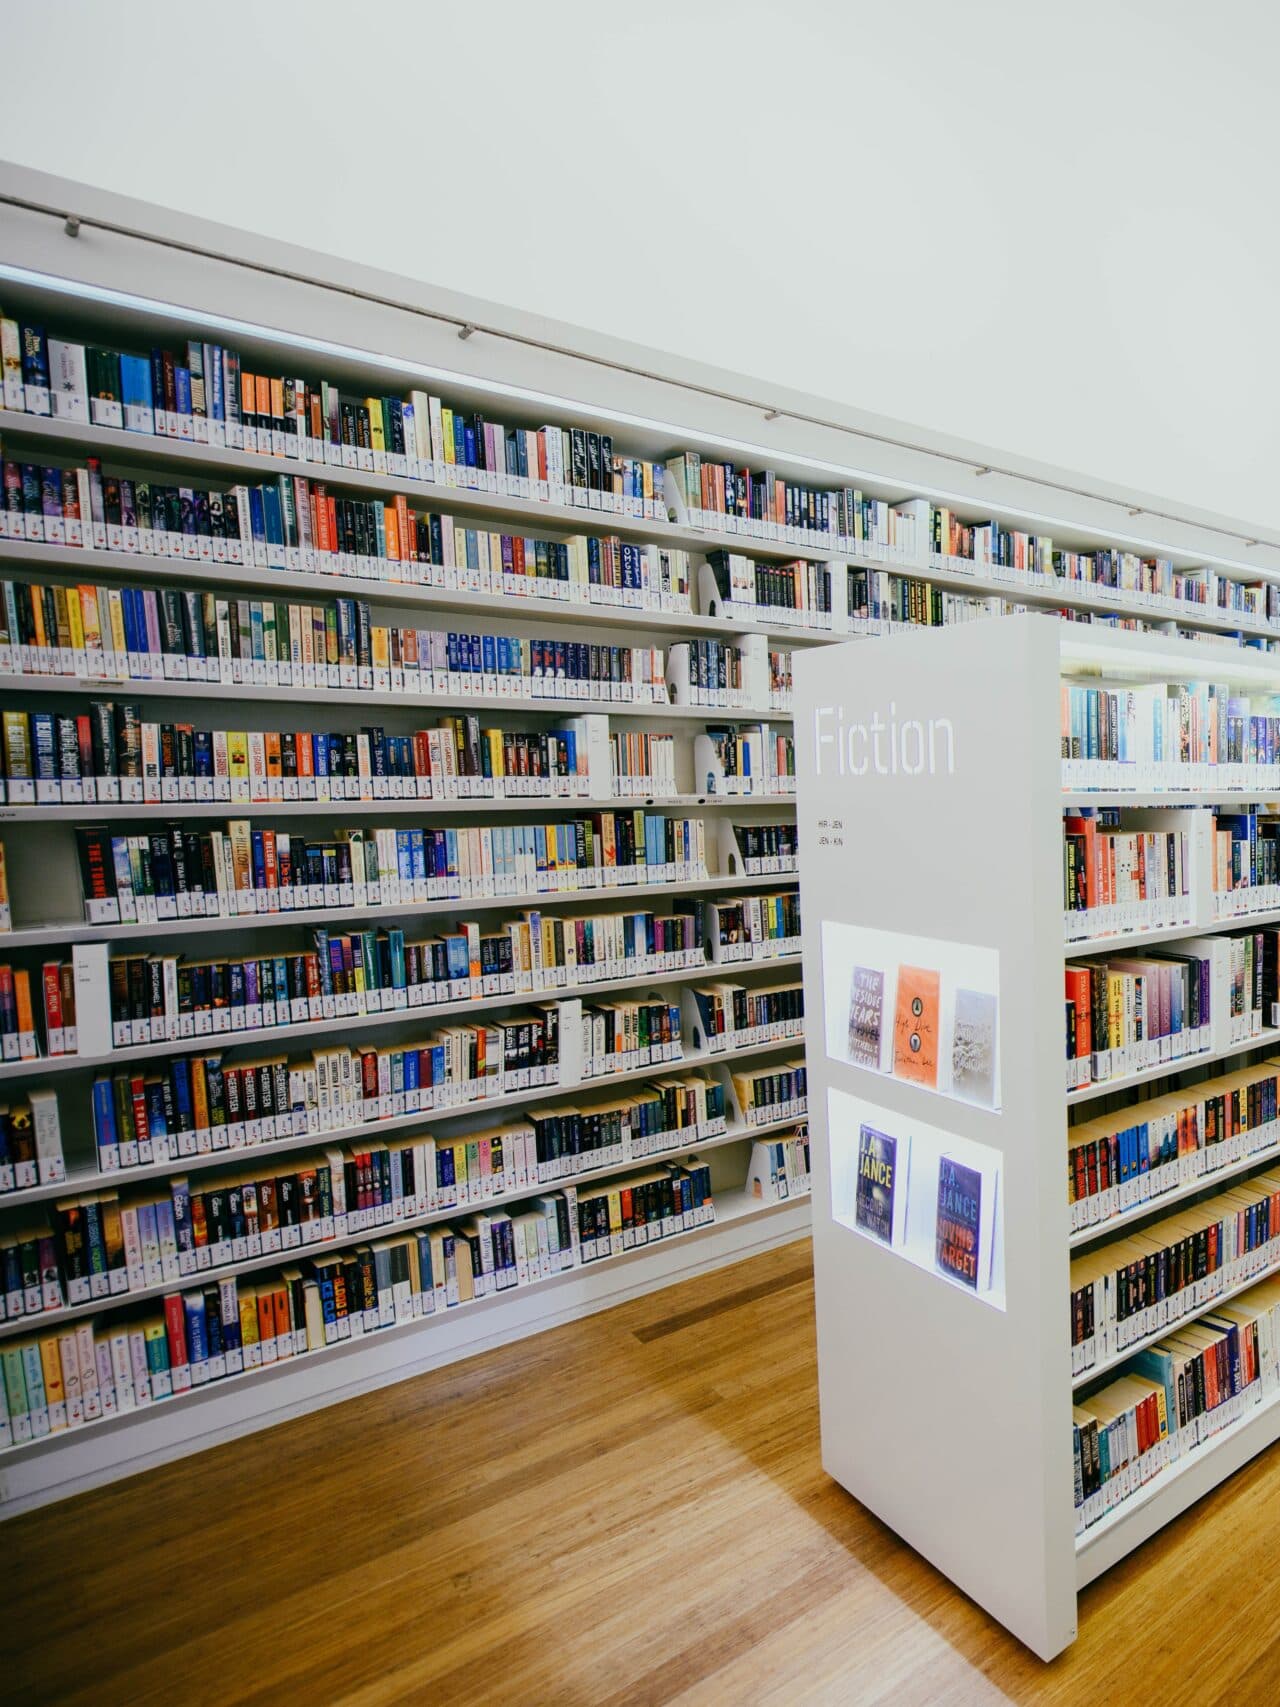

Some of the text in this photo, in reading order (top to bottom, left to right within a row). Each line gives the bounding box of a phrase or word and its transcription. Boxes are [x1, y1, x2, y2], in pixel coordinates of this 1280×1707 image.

[815, 702, 955, 776] Fiction
[88, 843, 108, 899] THE TUNNE
[136, 1105, 149, 1141] TRANC
[859, 1153, 893, 1189] JANCE
[940, 1189, 977, 1222] JANCE
